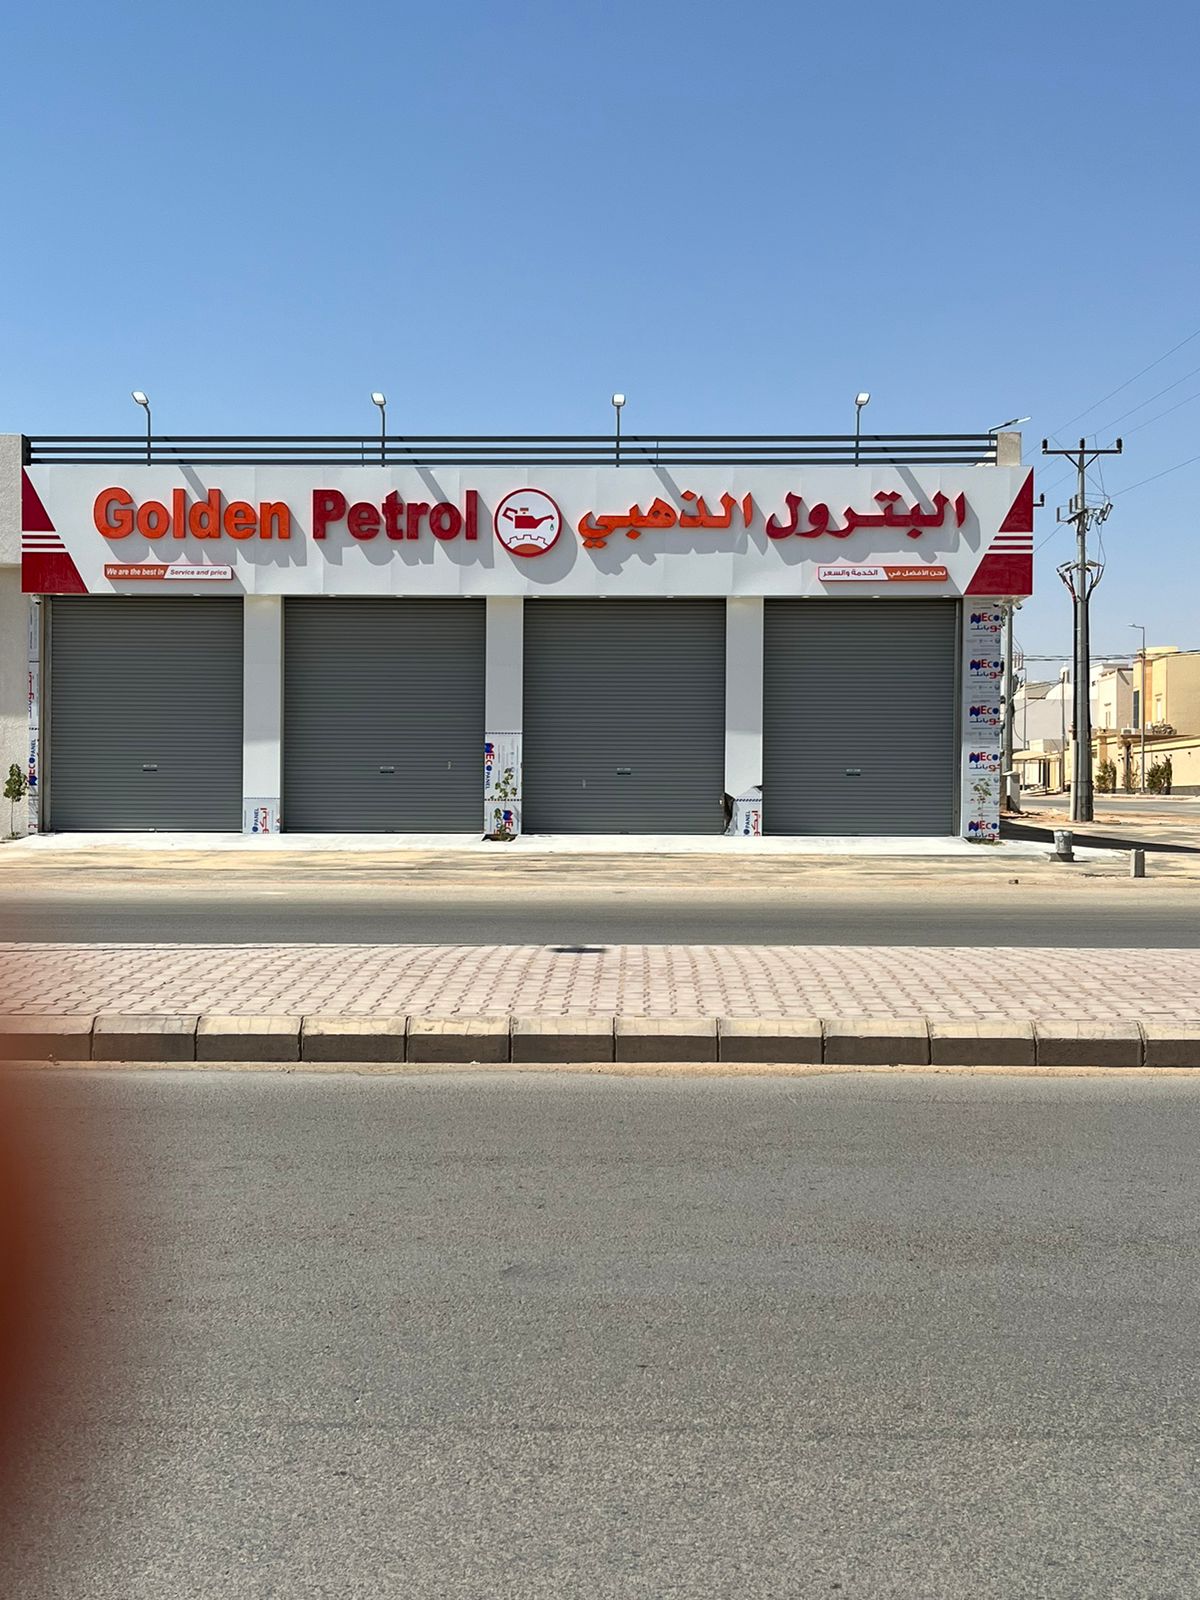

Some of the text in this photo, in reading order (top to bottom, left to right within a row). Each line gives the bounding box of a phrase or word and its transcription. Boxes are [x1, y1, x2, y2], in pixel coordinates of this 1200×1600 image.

[94, 487, 478, 541] Golden Petrol
[578, 490, 965, 548] البترول الذهبي
[106, 567, 117, 576] We
[118, 567, 129, 576] are
[130, 567, 141, 576] the
[142, 567, 157, 576] best
[196, 568, 209, 576] and
[210, 569, 227, 577] price
[823, 569, 850, 578] والسعر
[851, 568, 879, 577] الخدمة
[929, 569, 946, 577] نحن
